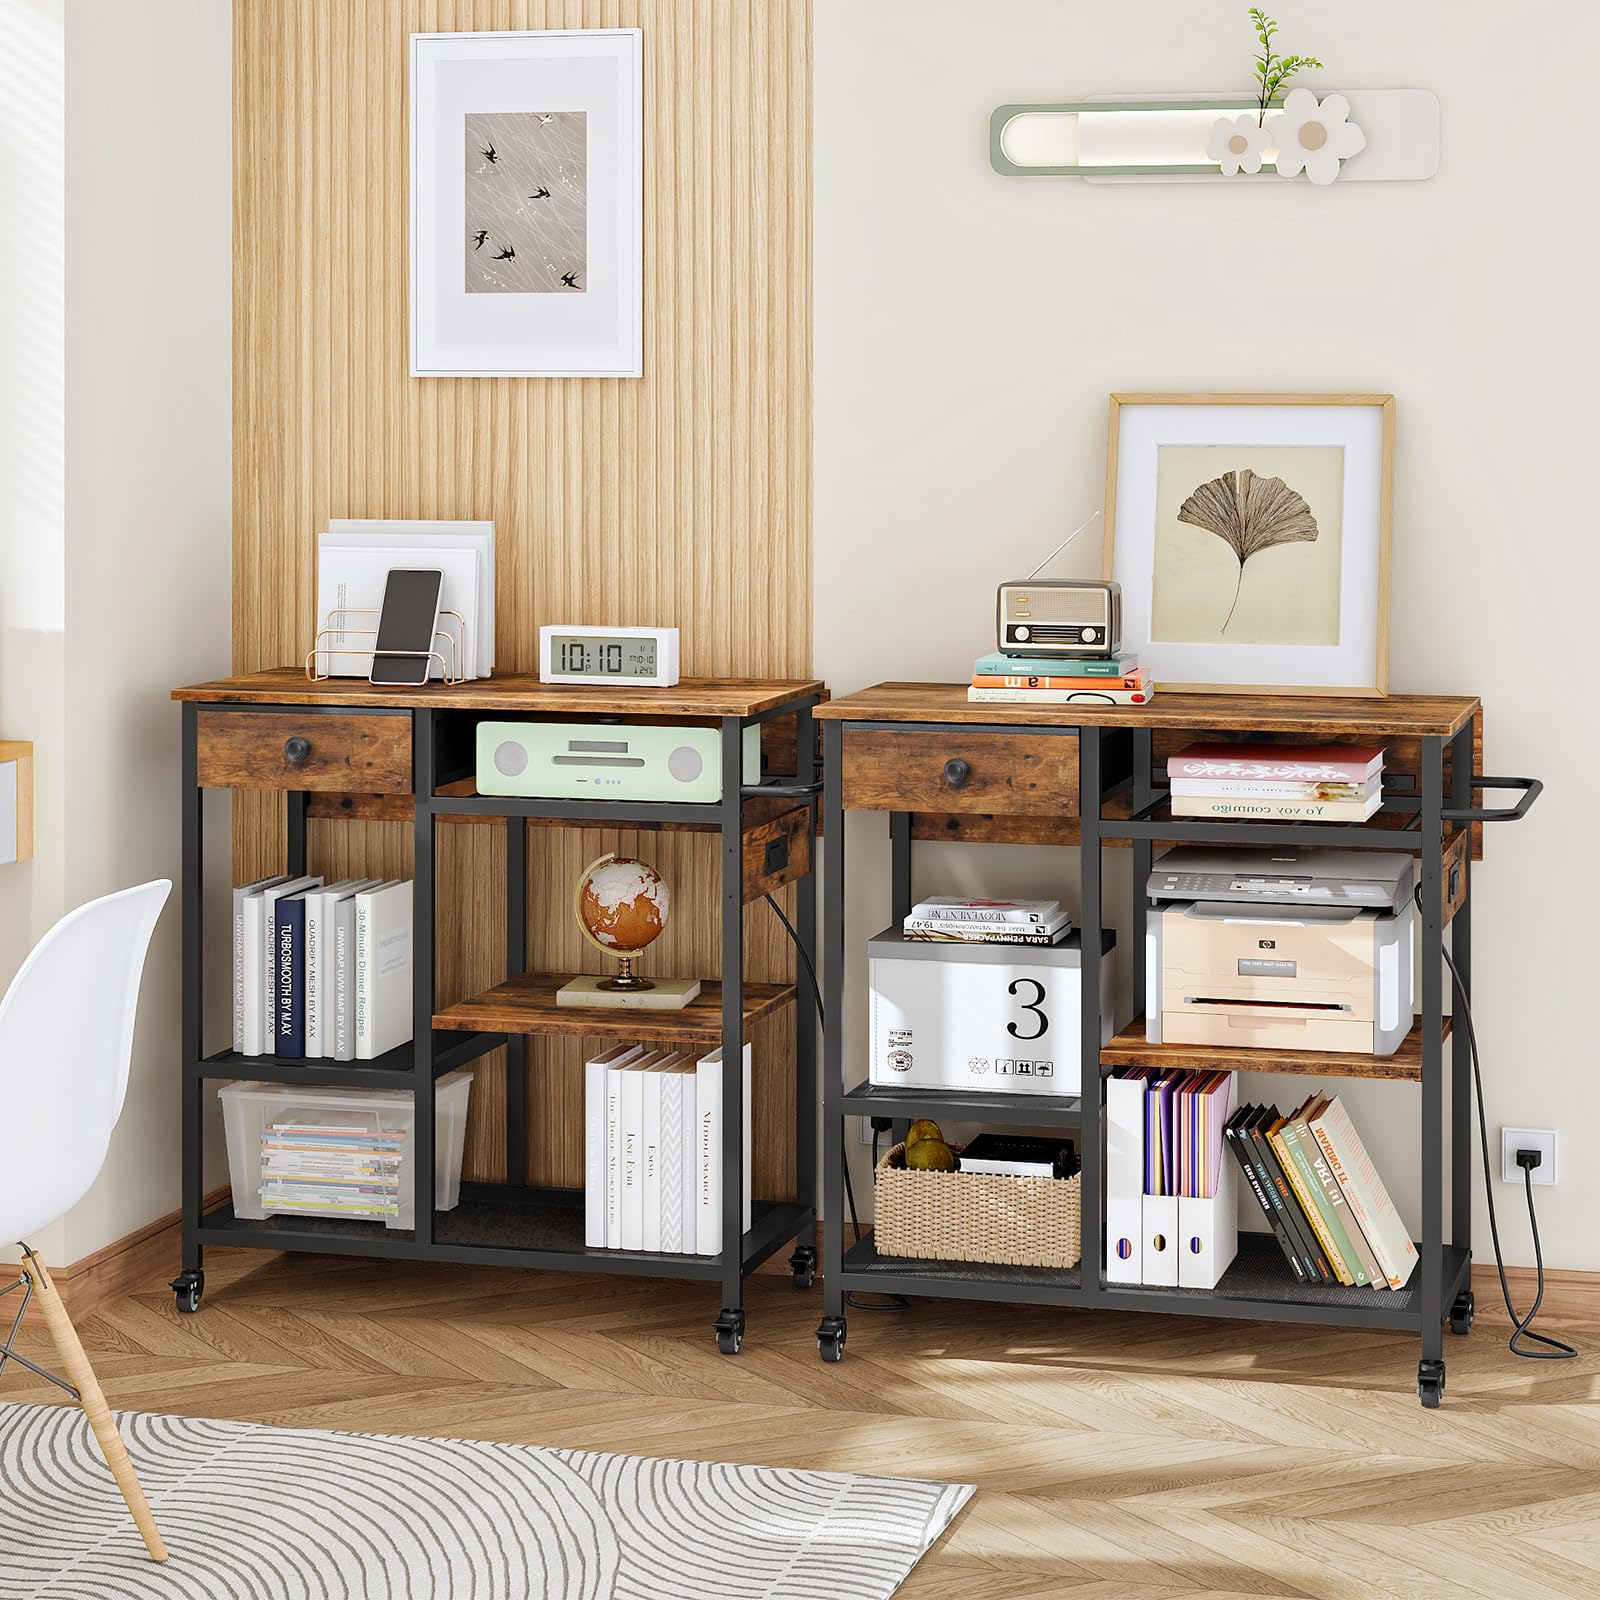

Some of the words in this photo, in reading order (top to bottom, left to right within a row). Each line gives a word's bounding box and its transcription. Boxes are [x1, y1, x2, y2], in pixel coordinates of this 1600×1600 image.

[562, 643, 622, 672] 10:10
[1004, 676, 1022, 688] m
[1028, 676, 1038, 688] a
[308, 920, 316, 968] QUADRIFY
[358, 909, 366, 958] 30-Minute
[1026, 935, 1049, 944] SARA
[281, 924, 292, 995] TURBOSMOOTH
[358, 961, 366, 994] Dinner
[268, 997, 274, 1009] BY
[281, 998, 292, 1011] BY
[309, 1000, 316, 1012] BY
[1006, 978, 1049, 1040] 3
[281, 1012, 292, 1035] M.AX
[337, 1016, 344, 1027] BY
[357, 997, 366, 1037] Recipes
